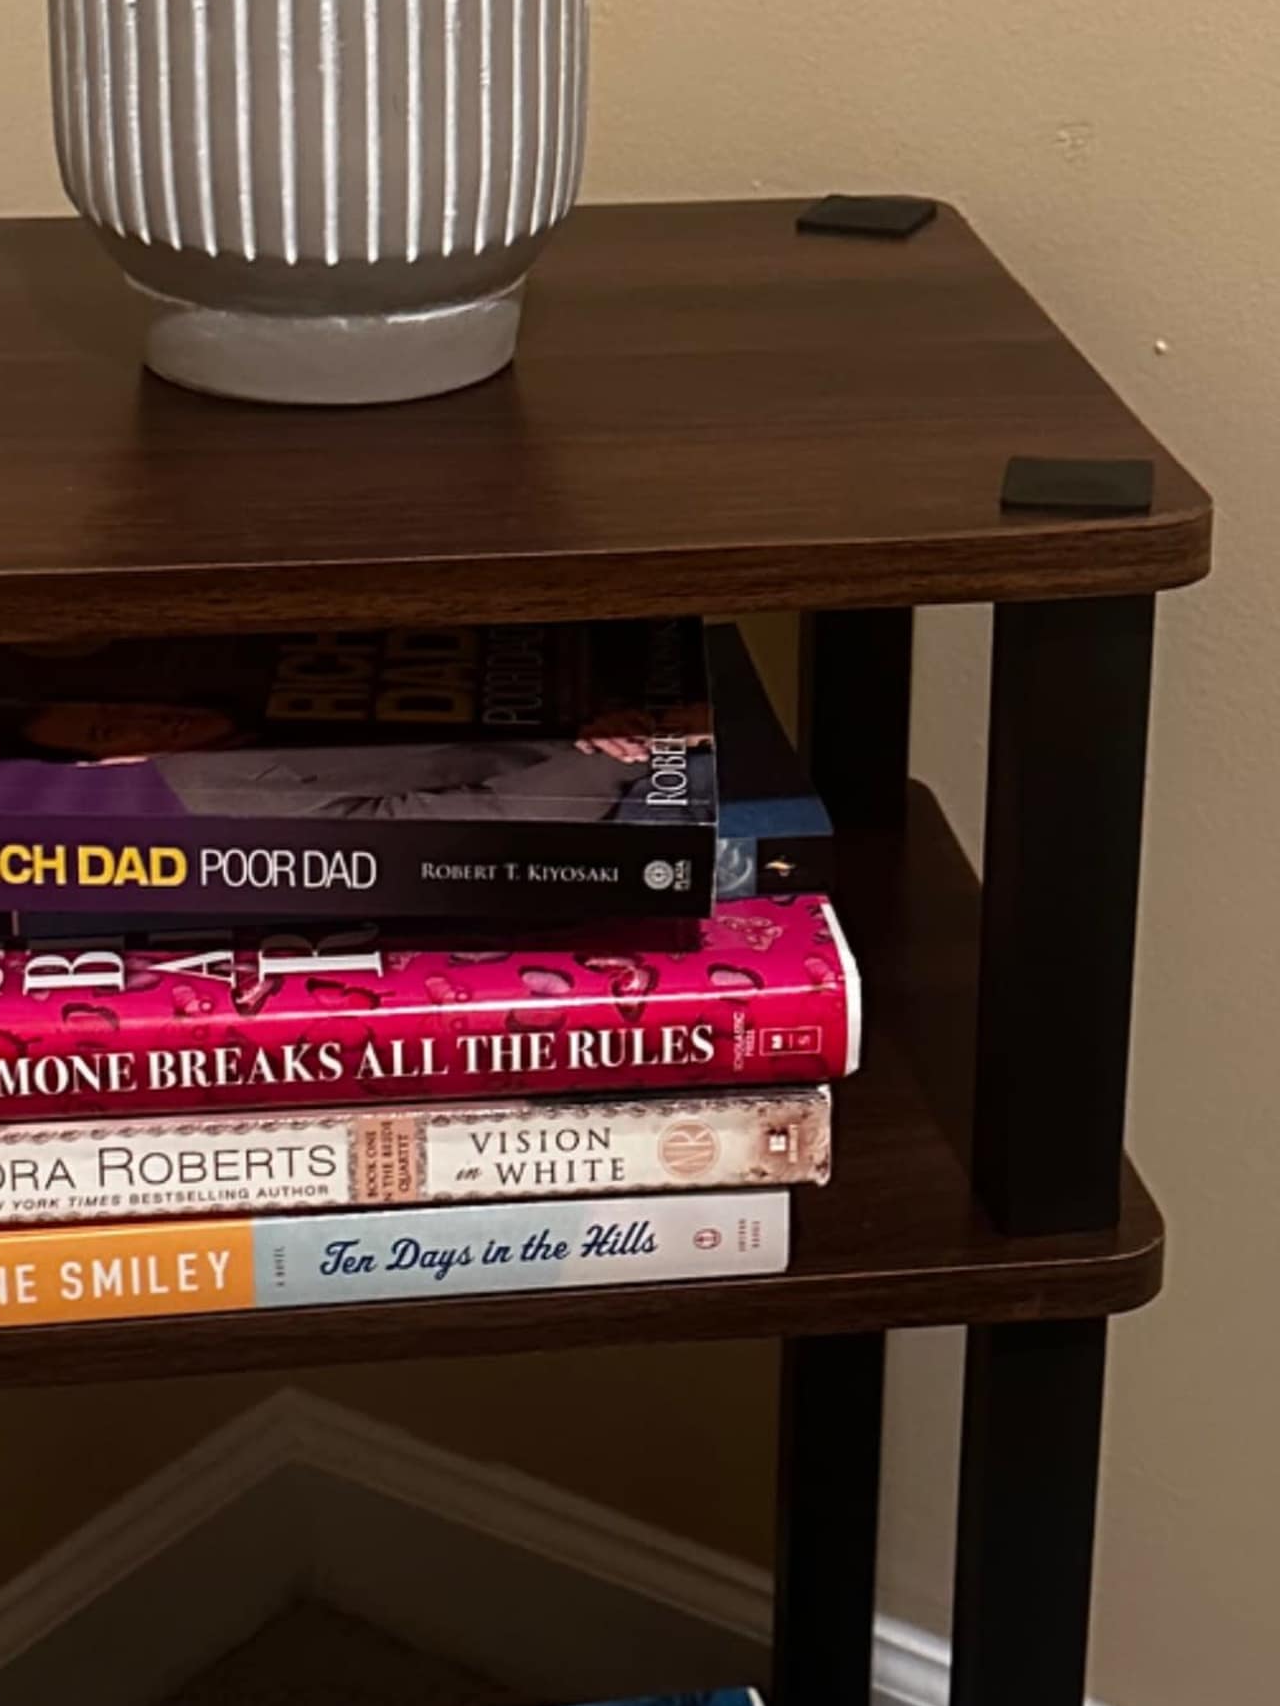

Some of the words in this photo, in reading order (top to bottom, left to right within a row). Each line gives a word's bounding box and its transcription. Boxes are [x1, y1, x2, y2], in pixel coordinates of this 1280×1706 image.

[77, 846, 188, 887] DAD
[201, 849, 296, 888] POOR
[303, 850, 377, 890] DAD
[421, 861, 497, 881] ROBERT
[505, 862, 519, 881] T.
[527, 863, 619, 883] KIYOSAKI
[149, 1041, 343, 1090] BREAKS
[354, 1036, 448, 1080] ALL
[457, 1032, 557, 1075] THE
[568, 1024, 715, 1069] RULES
[469, 1127, 612, 1155] VISION
[97, 1144, 337, 1188] ROBERTS
[366, 1160, 378, 1198] BOOK
[455, 1167, 481, 1182] in
[495, 1157, 626, 1185] WHITE
[11, 1197, 60, 1212] YORK
[68, 1194, 122, 1209] TIMES
[129, 1188, 251, 1206] BESTSELLING
[256, 1184, 330, 1201] AUTHOR
[320, 1238, 376, 1276] Ten
[386, 1236, 473, 1281] Days
[482, 1238, 513, 1265] in
[520, 1228, 571, 1262] the
[580, 1220, 658, 1258] Hills
[60, 1250, 231, 1301] SMILEY
